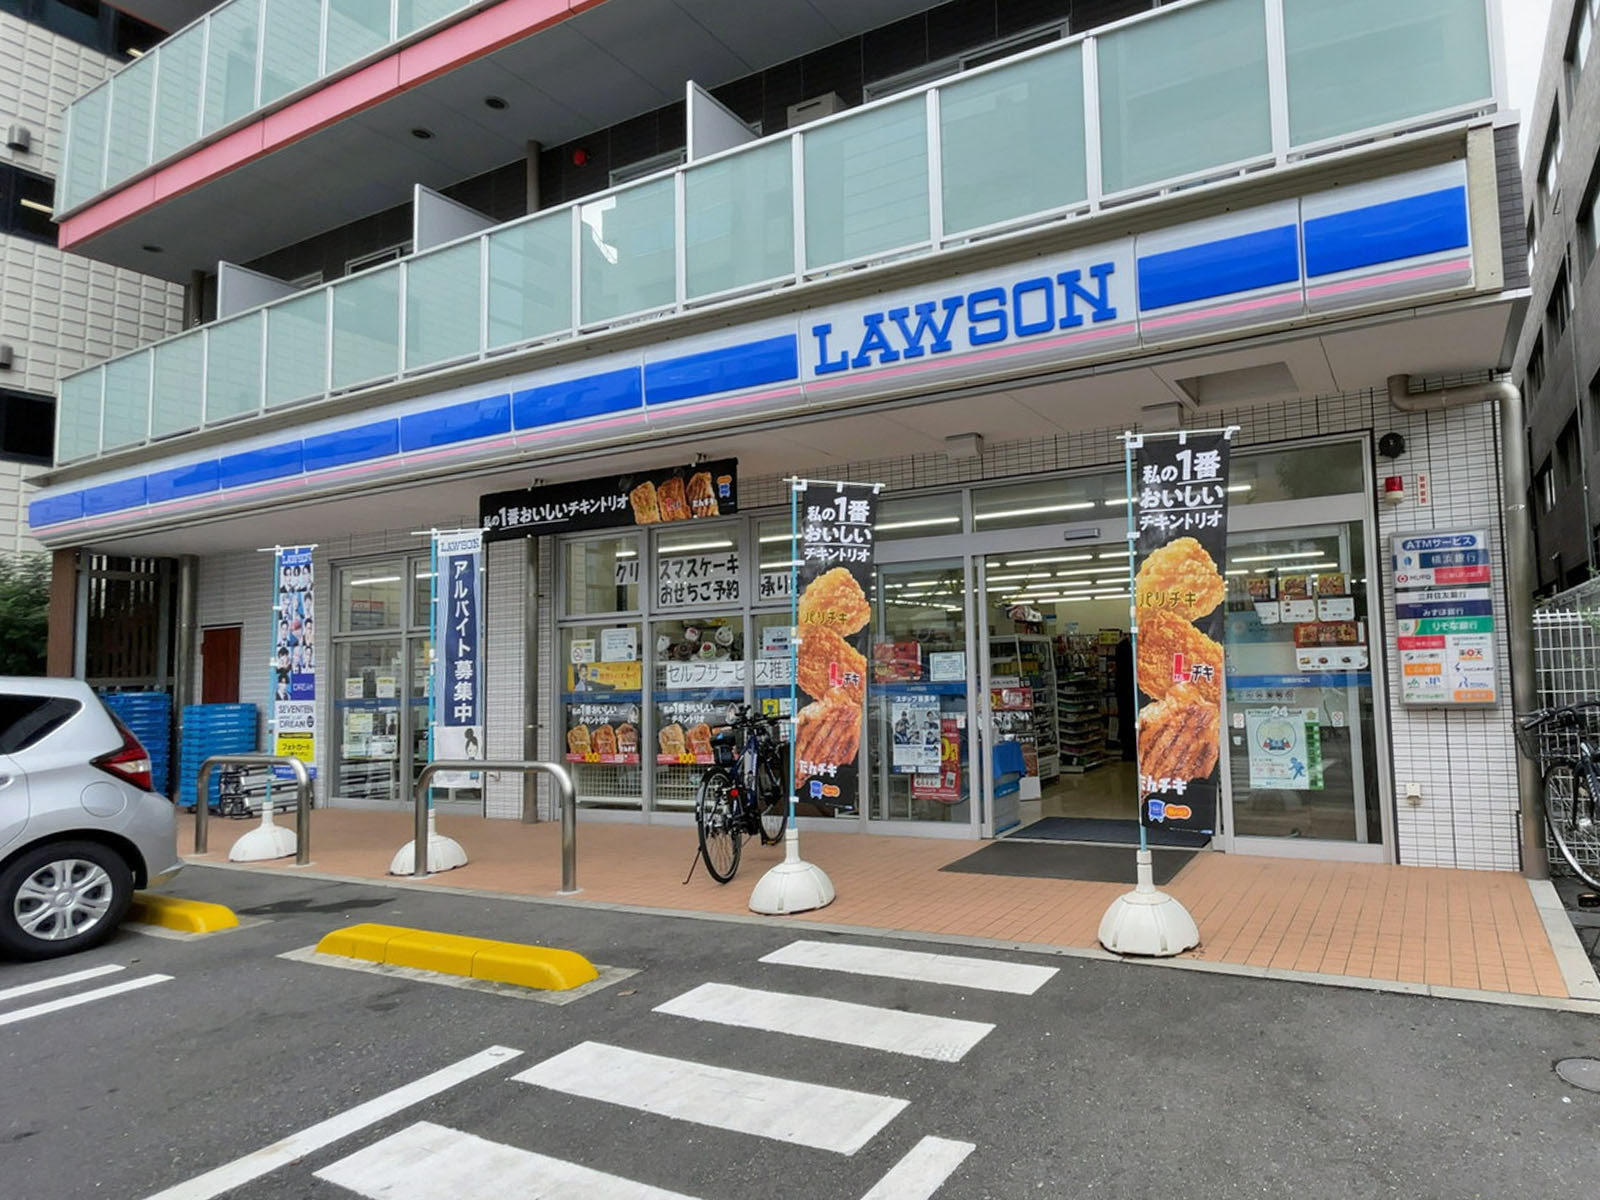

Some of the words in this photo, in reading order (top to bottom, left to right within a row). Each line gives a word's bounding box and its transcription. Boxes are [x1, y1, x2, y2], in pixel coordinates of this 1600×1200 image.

[812, 262, 1117, 375] LAWSON
[1143, 449, 1221, 484] 私の1番
[807, 496, 870, 522] 私の1番
[1139, 485, 1224, 509] おいしい
[1139, 511, 1223, 531] チキントリオ
[804, 525, 872, 544] おいしい
[1406, 535, 1473, 549] ATMサービス
[804, 548, 870, 562] チキントリオ
[616, 562, 639, 583] クリ
[660, 554, 739, 580] スマスケーキ
[660, 580, 740, 605] おせちご予約
[1140, 591, 1196, 608] パリチキ
[804, 611, 848, 624] パリチキ
[1423, 608, 1464, 617] みずほ銀行
[1432, 620, 1478, 631] りそな銀行
[453, 561, 473, 723] アルバイト募集中
[830, 662, 860, 687] Lチキ
[1174, 653, 1213, 682] Lチキ
